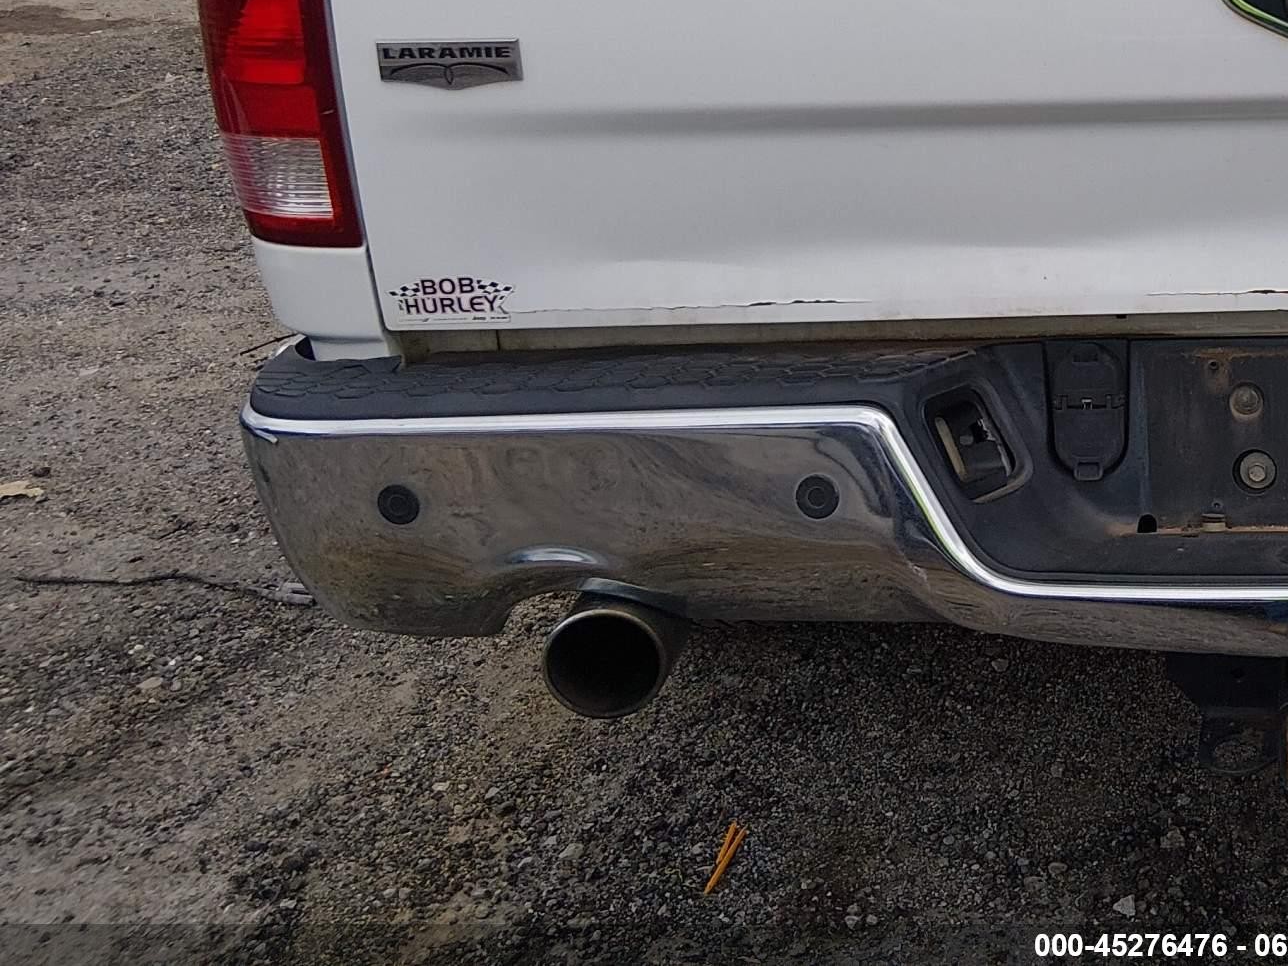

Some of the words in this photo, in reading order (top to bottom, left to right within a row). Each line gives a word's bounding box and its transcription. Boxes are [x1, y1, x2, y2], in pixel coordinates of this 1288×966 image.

[382, 46, 513, 60] LARAMIE
[420, 277, 475, 296] BOB
[404, 295, 499, 315] HURLEY
